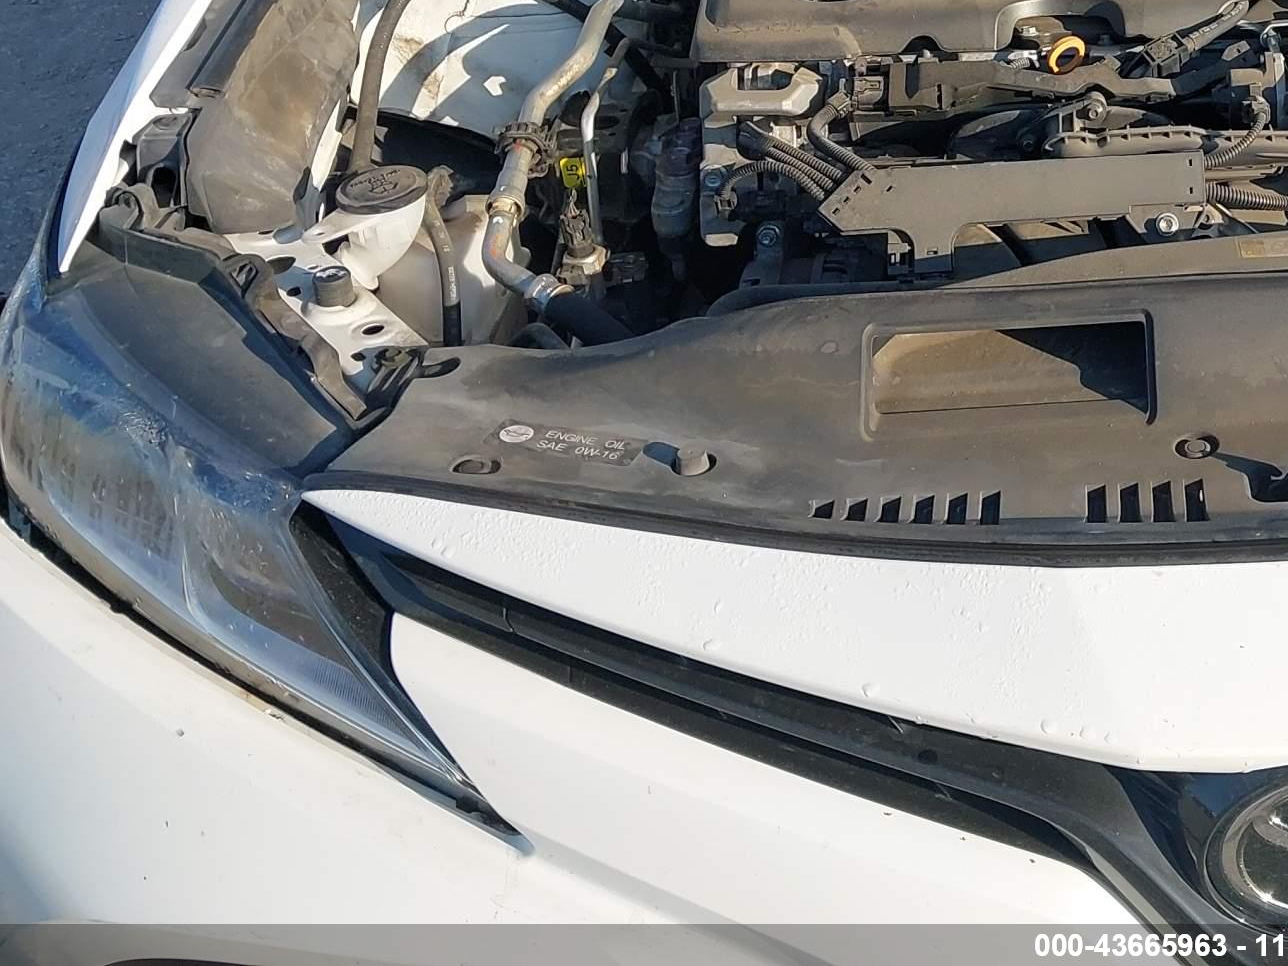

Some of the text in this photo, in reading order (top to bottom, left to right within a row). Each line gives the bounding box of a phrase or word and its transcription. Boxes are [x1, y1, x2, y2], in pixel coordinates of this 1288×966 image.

[536, 440, 619, 460] SAE 0W-16
[545, 430, 625, 450] ENGINE OIL
